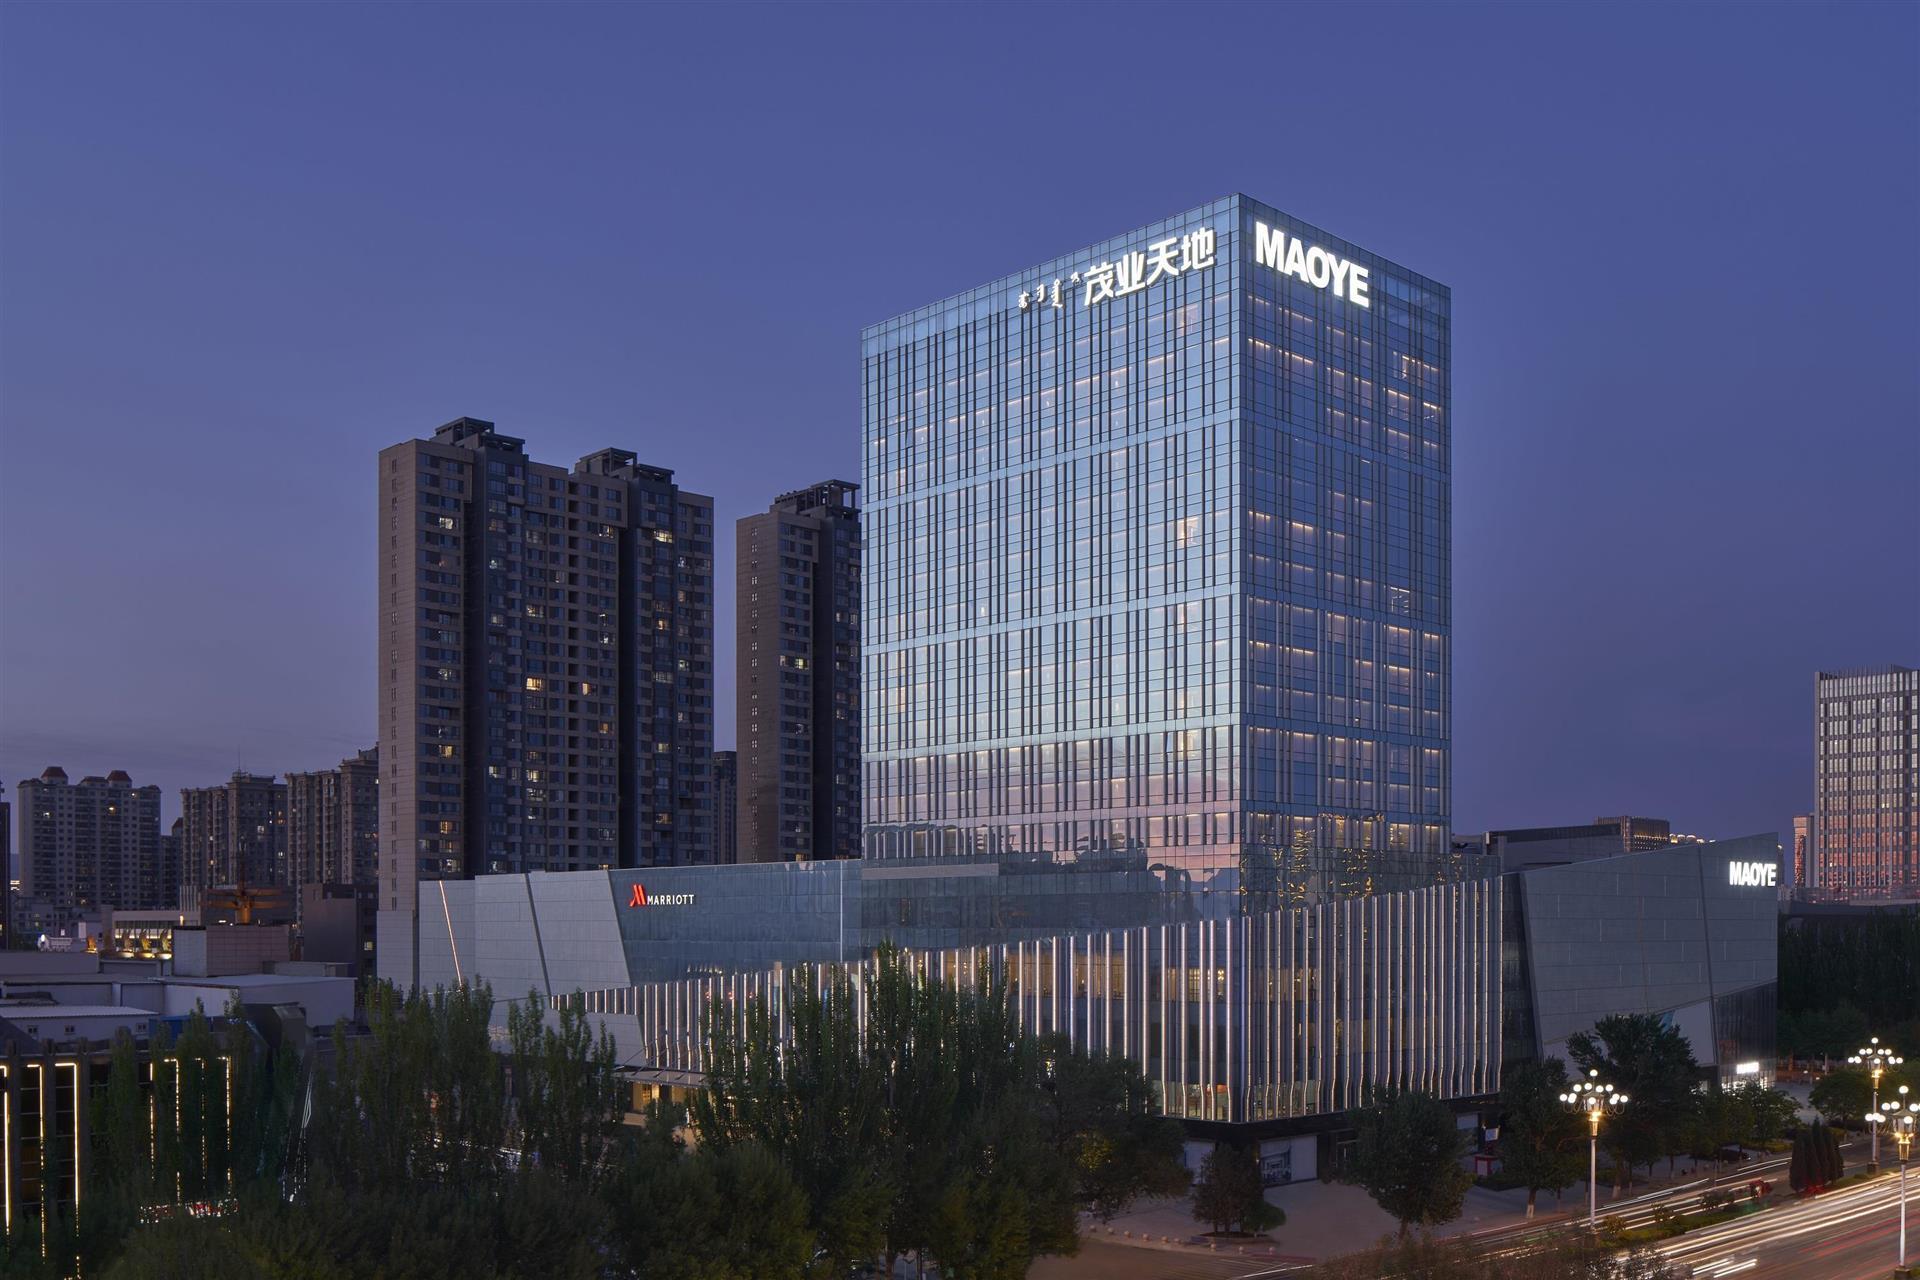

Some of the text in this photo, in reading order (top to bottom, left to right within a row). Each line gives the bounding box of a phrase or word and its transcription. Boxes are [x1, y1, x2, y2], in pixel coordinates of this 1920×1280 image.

[1083, 226, 1215, 306] 茂业天地
[1255, 221, 1370, 308] MAOYE
[646, 894, 695, 905] MARRIOTT
[1729, 861, 1777, 887] MAOYE
